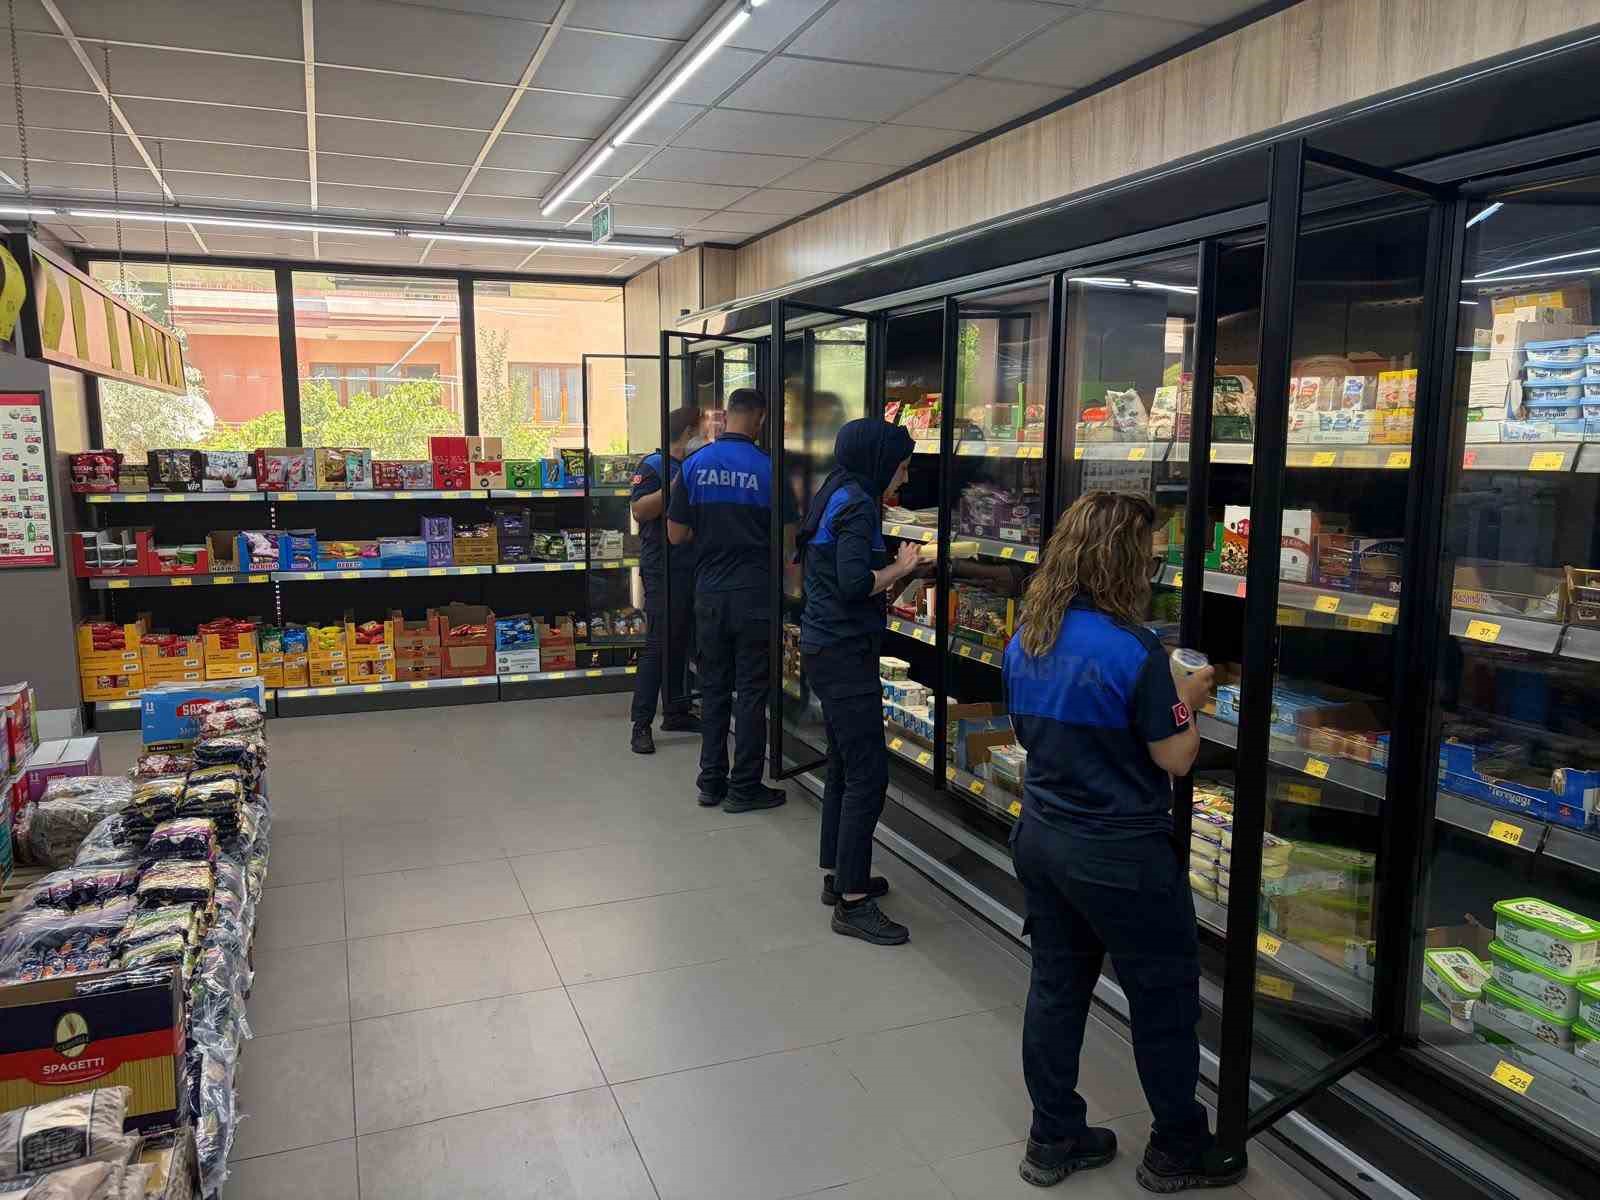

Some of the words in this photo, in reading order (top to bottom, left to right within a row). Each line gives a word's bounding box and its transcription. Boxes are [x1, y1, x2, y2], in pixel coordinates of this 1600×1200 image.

[696, 469, 759, 491] ZABITA
[42, 1056, 105, 1075] SPAGETTI
[1508, 1074, 1528, 1089] 225
